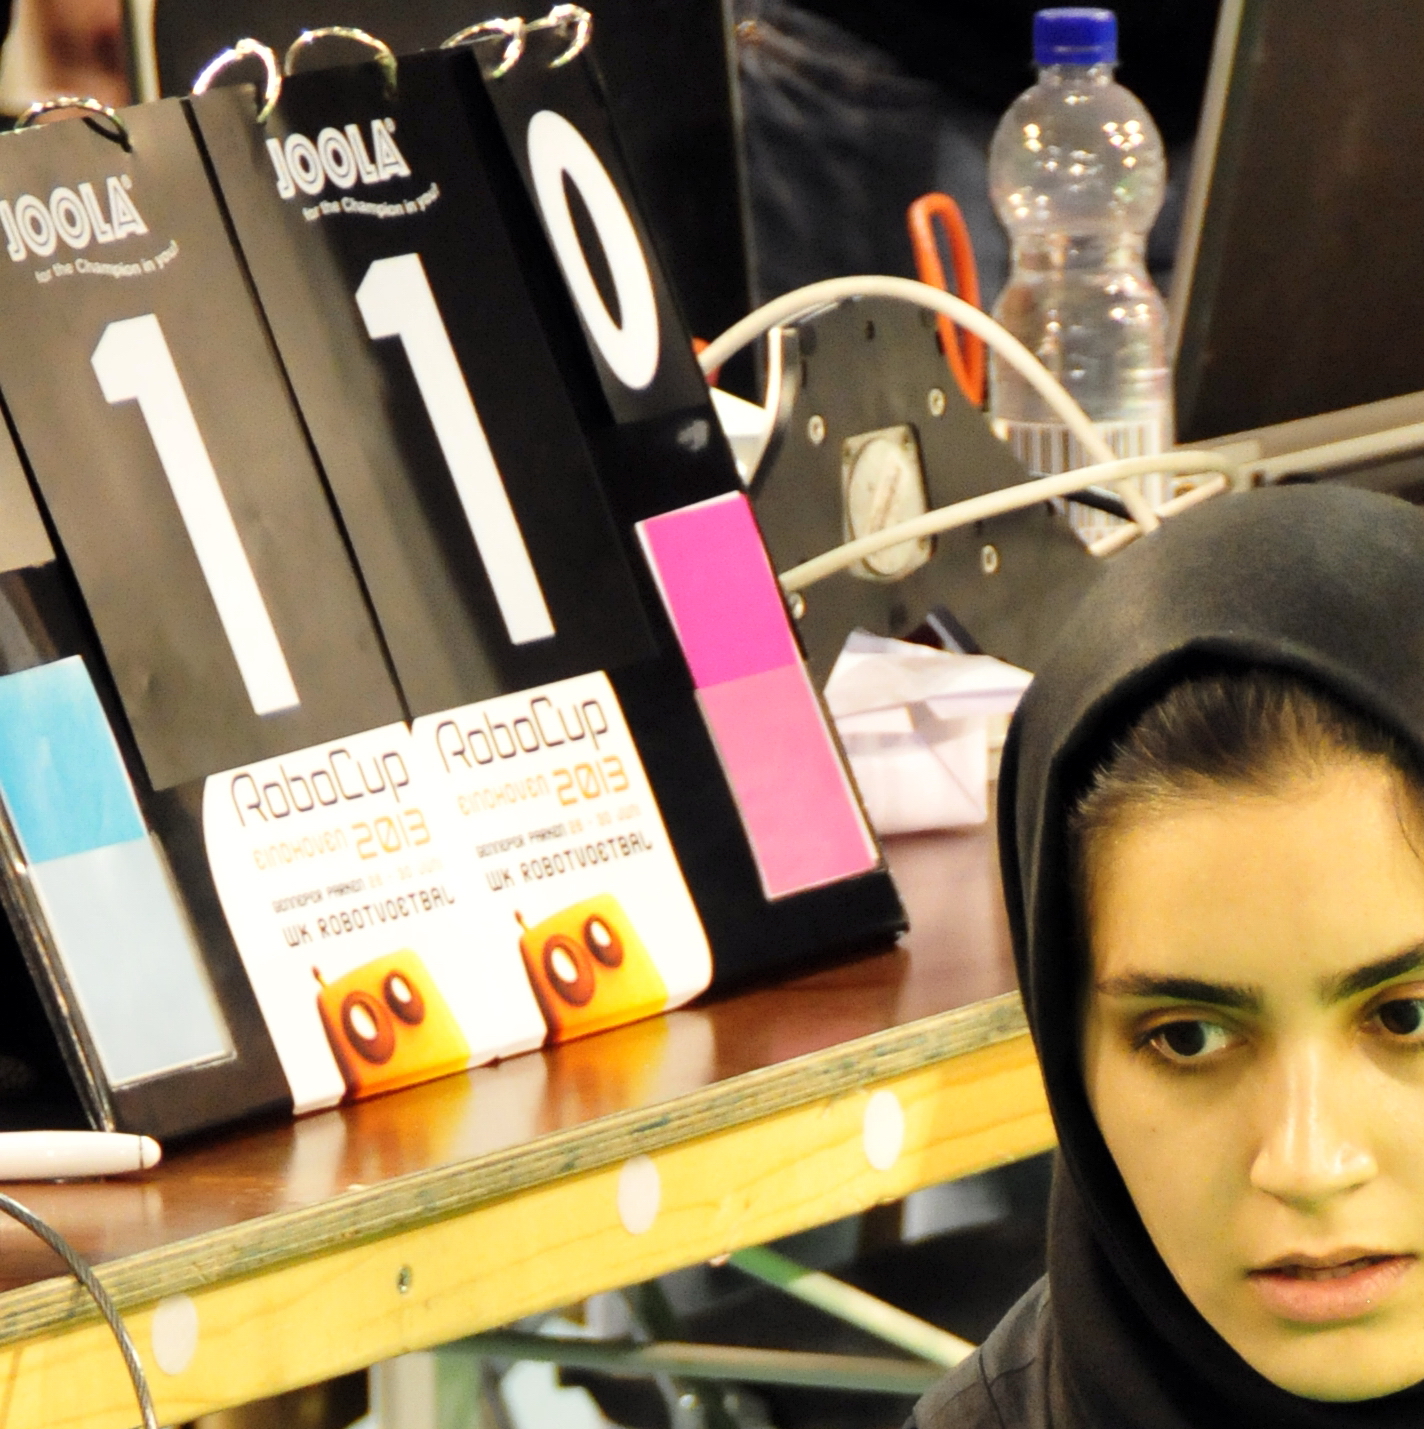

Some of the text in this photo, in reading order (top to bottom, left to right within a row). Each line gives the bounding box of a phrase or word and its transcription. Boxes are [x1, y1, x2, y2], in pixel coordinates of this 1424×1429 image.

[266, 118, 411, 199] JOOLA
[0, 176, 149, 262] JOOLA
[319, 200, 341, 215] the
[340, 196, 406, 219] Champion
[52, 262, 75, 277] the
[74, 258, 142, 279] Champion
[527, 110, 659, 390] 0
[355, 252, 556, 646] 1
[90, 313, 300, 716] 1
[435, 696, 609, 773] RoboCup
[230, 748, 410, 827] RoboCup
[552, 755, 630, 807] 2013
[351, 808, 431, 860] 2013
[485, 867, 515, 892] WK
[519, 831, 653, 883] ROBOTVOETBAL
[282, 885, 455, 947] WK ROBOTVOETBAL
